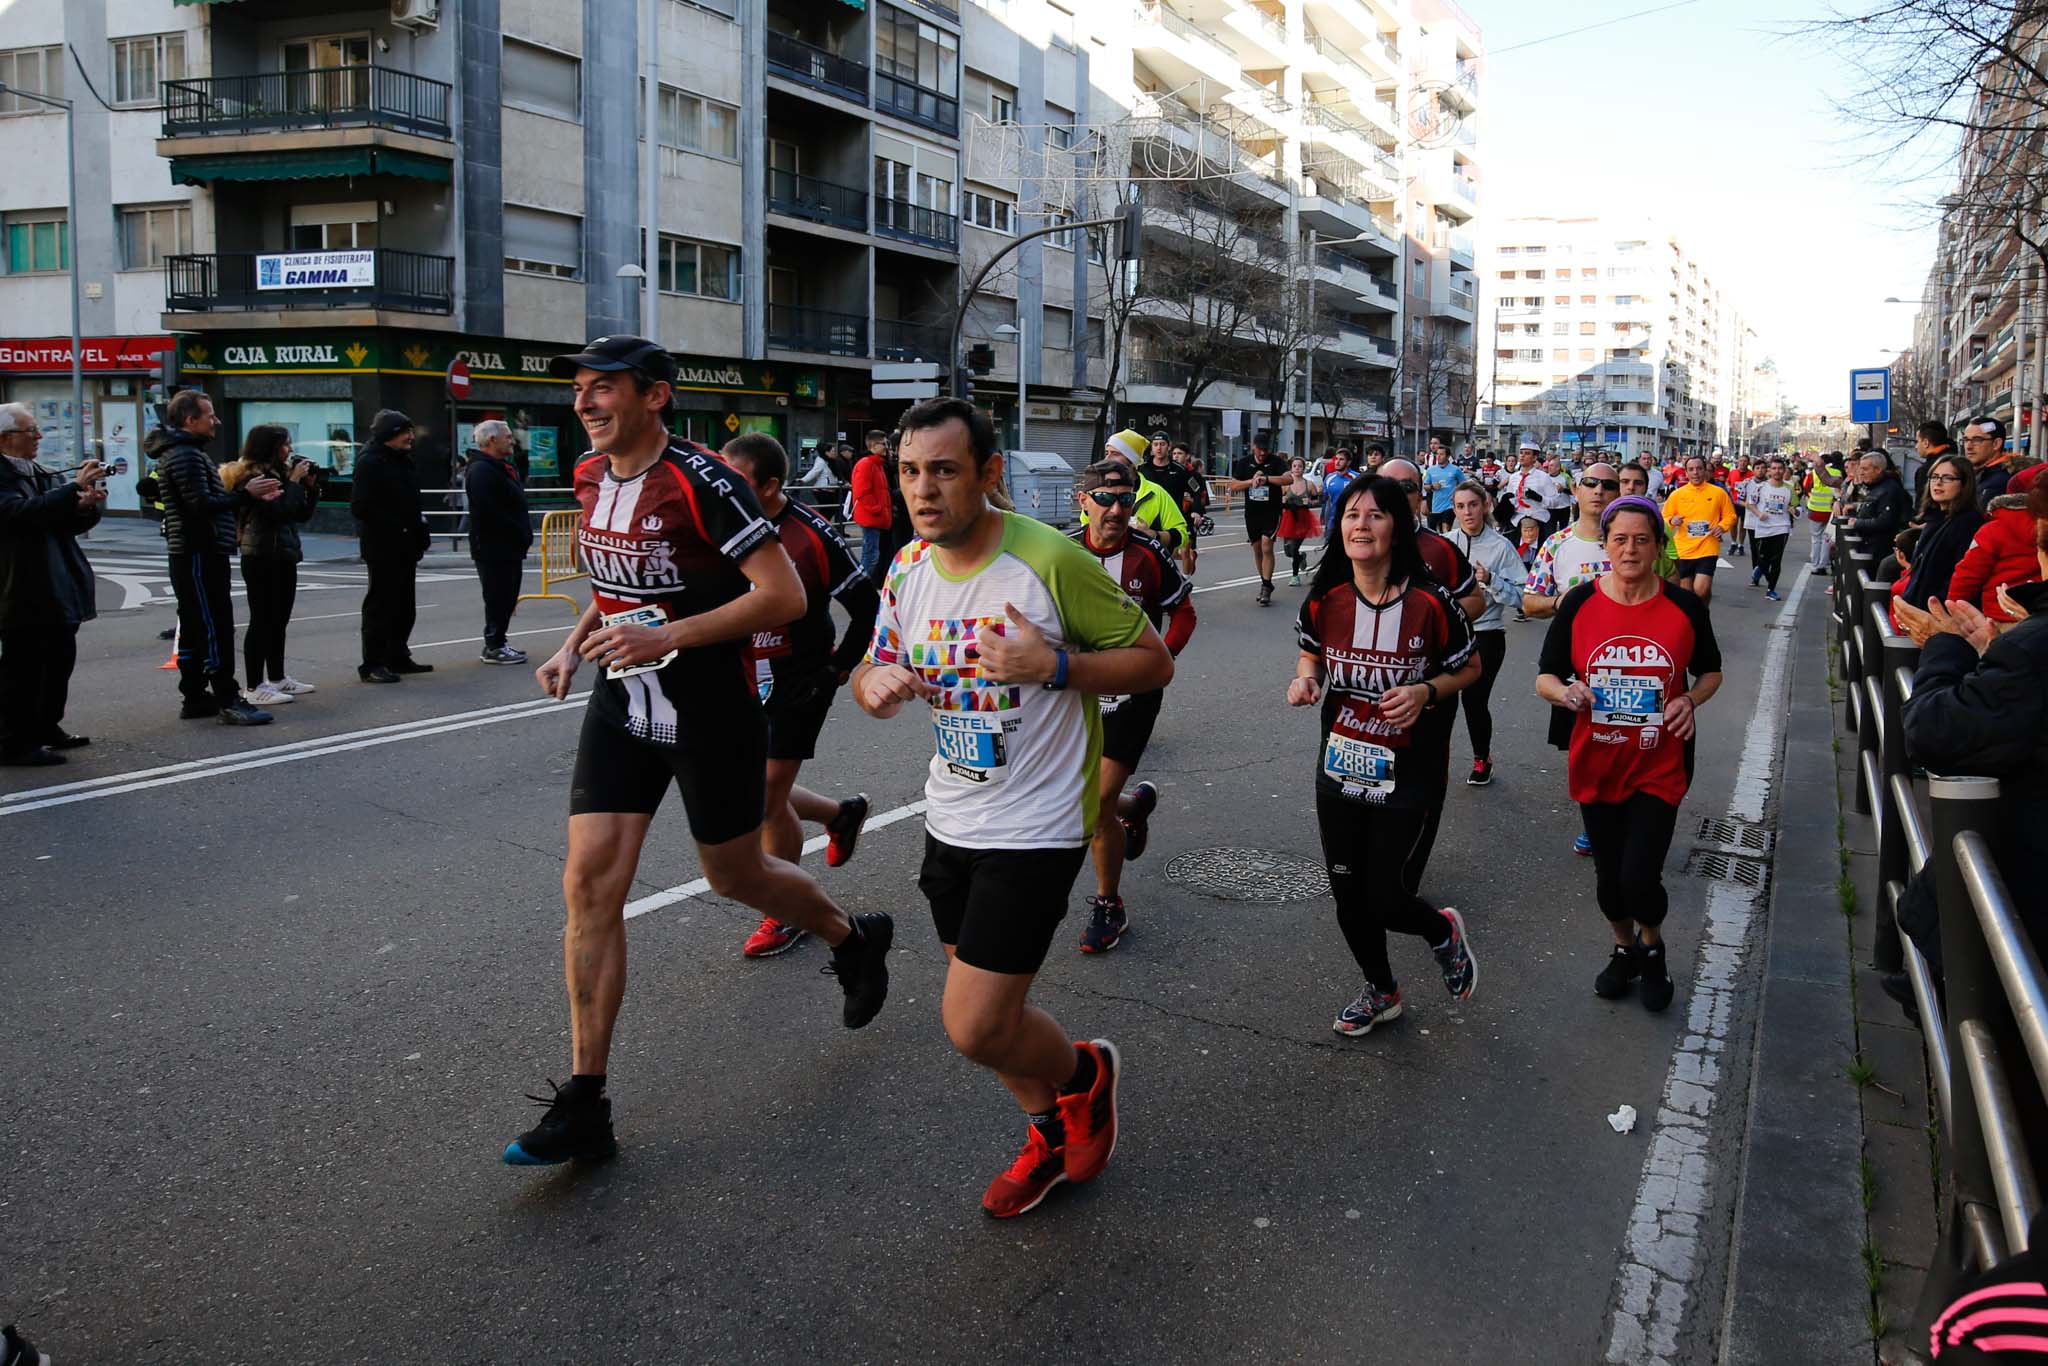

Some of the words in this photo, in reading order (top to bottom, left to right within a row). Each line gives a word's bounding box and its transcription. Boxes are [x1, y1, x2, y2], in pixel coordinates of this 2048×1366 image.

[313, 256, 323, 265] DE
[324, 253, 372, 265] FISIOTERAPIA
[285, 269, 348, 285] GAMMA
[224, 346, 268, 365] CAJA
[275, 345, 338, 364] RURAL
[676, 367, 745, 385] AMANCA
[685, 454, 733, 497] RLR
[1326, 647, 1423, 665] RUNNING
[1605, 645, 1659, 662] 2019
[1610, 678, 1657, 688] SETEL
[1602, 688, 1643, 709] 3152
[940, 715, 993, 730] SETEL
[940, 728, 980, 761] 4318
[1343, 741, 1388, 757] SETEL
[1333, 750, 1377, 777] 2888
